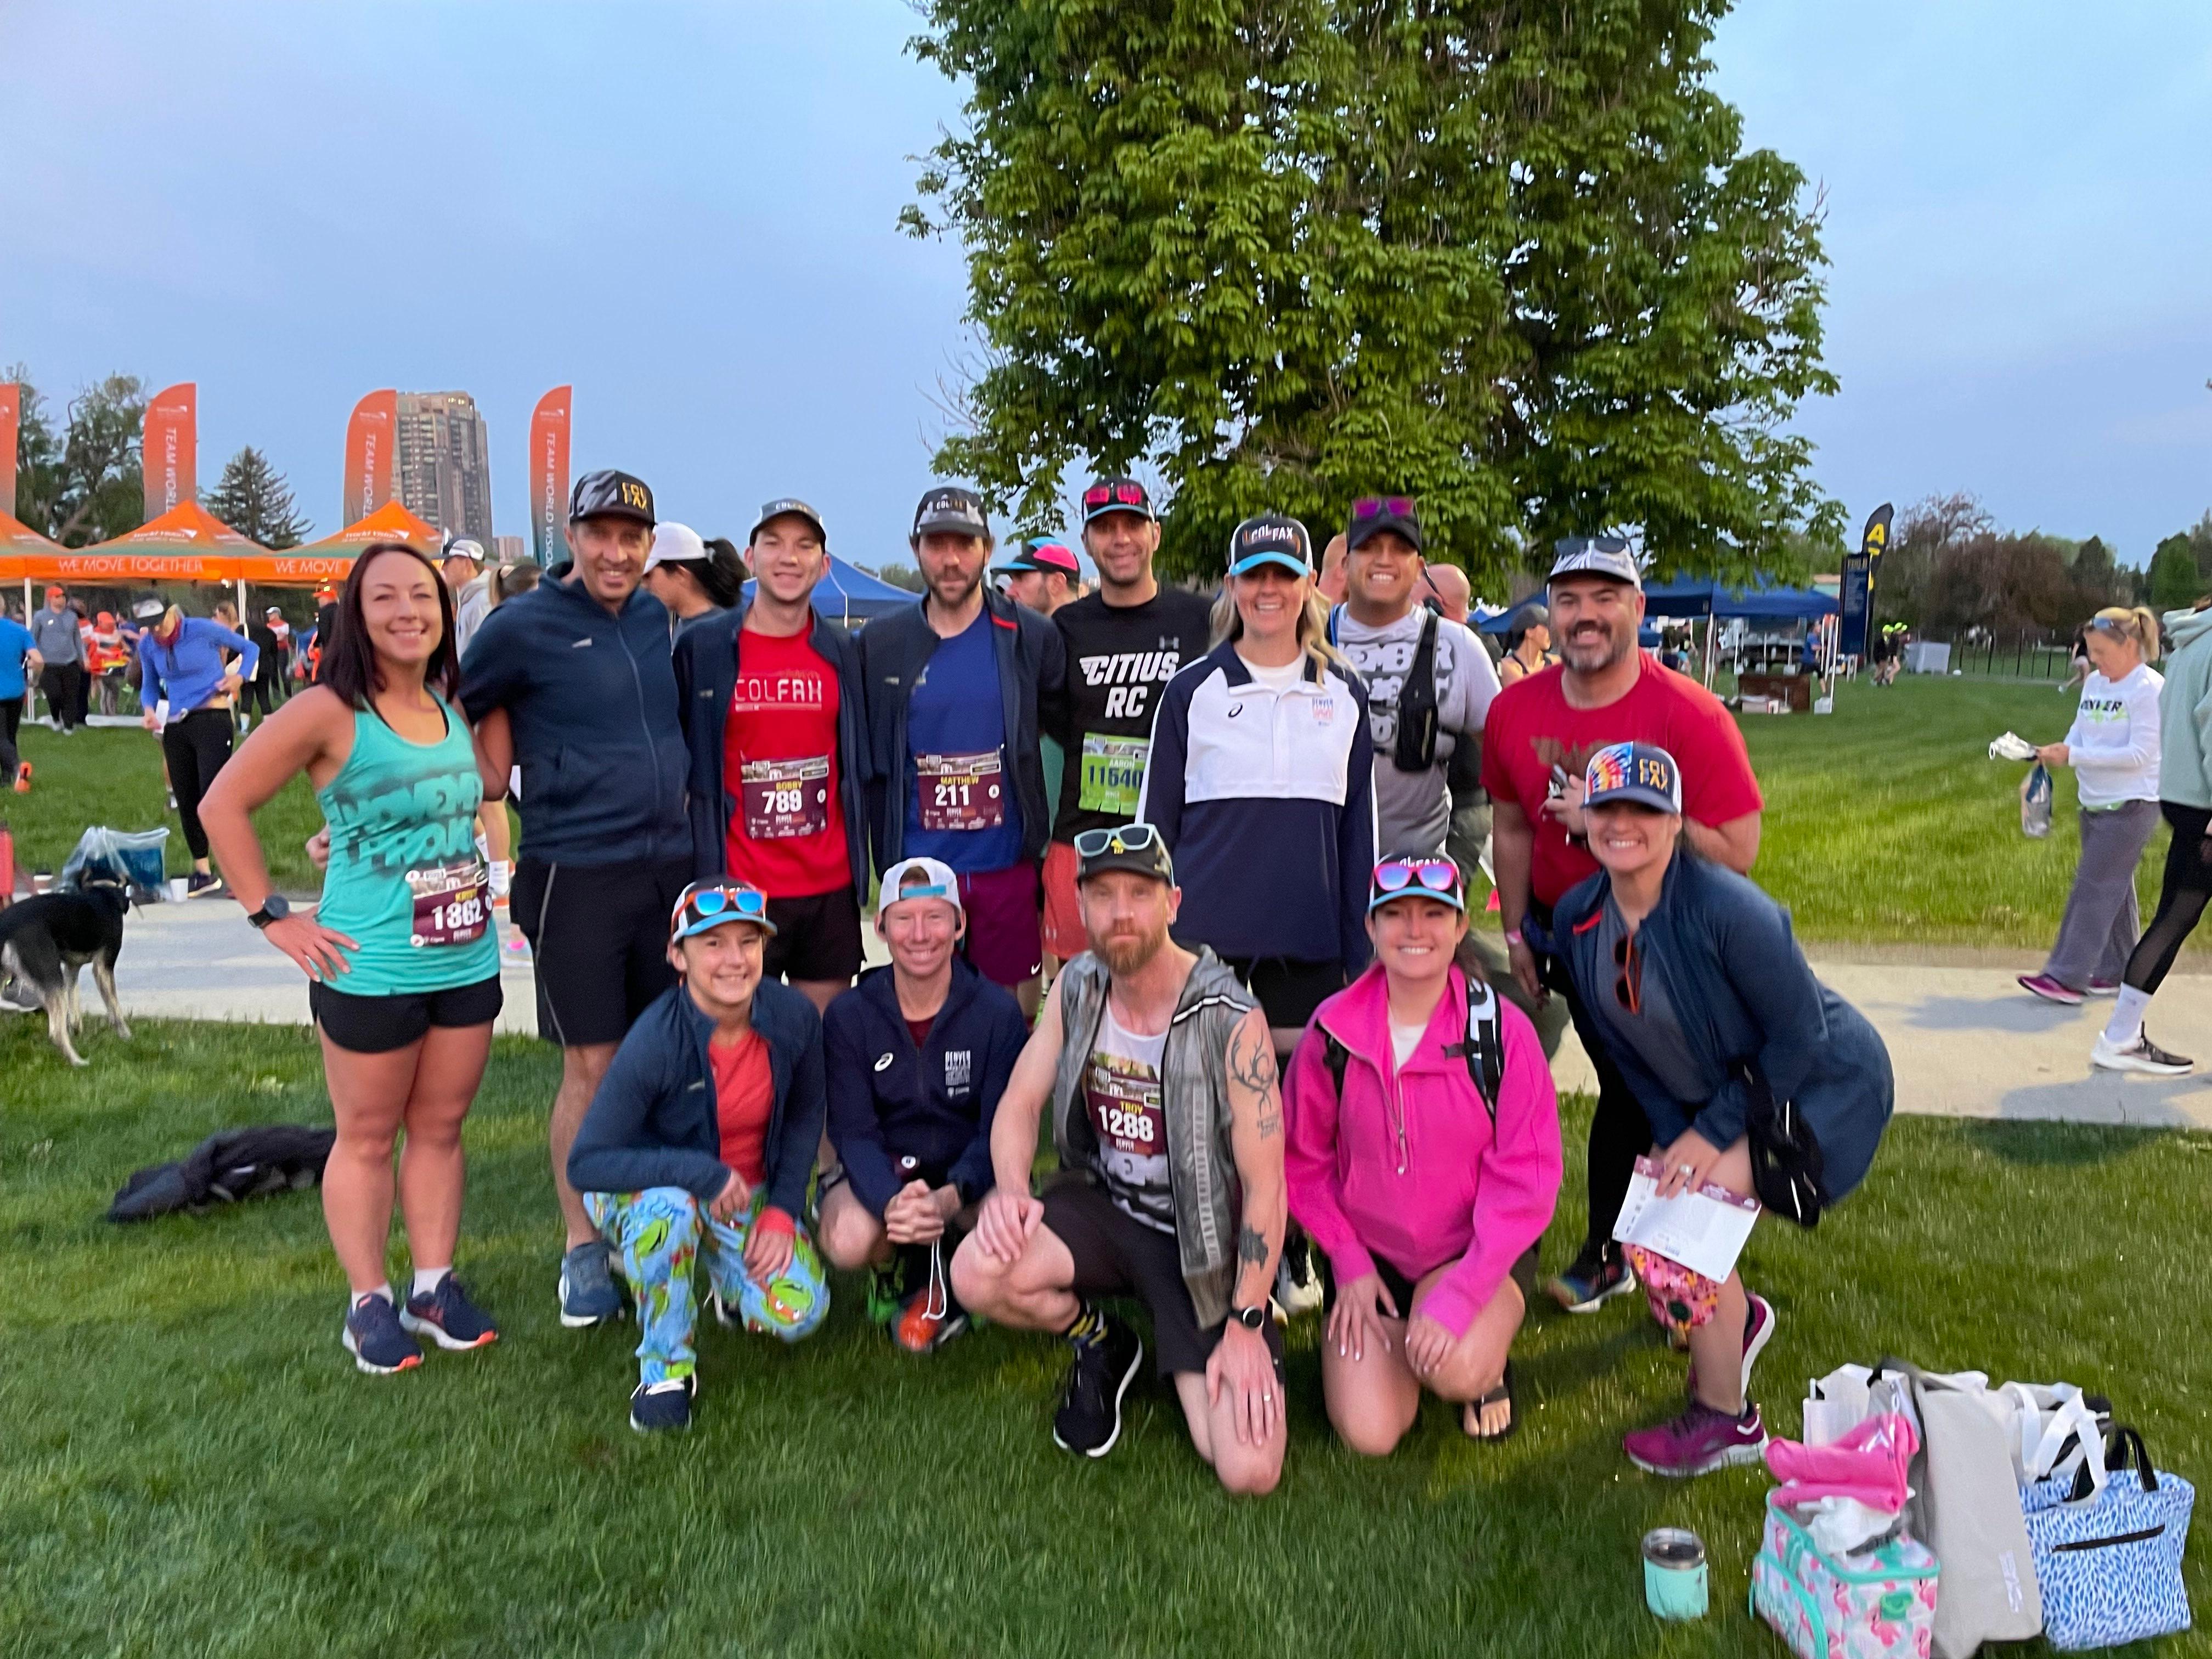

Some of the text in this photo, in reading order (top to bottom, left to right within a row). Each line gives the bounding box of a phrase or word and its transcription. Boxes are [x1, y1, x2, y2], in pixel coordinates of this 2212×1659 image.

[547, 433, 555, 469] TEAM
[166, 427, 176, 513] TEAM WORL
[363, 433, 376, 518] TEAM WORL
[545, 473, 554, 523] WORLD
[1251, 524, 1293, 542] COLFAX
[59, 558, 204, 572] WE MOVE TOGETHER
[275, 560, 296, 574] WE
[1079, 651, 1180, 686] CITIUS
[1105, 686, 1148, 718] RC
[940, 775, 979, 785] MATTHEW
[761, 788, 802, 814] 789
[935, 784, 969, 806] 211
[1120, 1101, 1143, 1115] TROY
[1098, 1104, 1154, 1142] 1288
